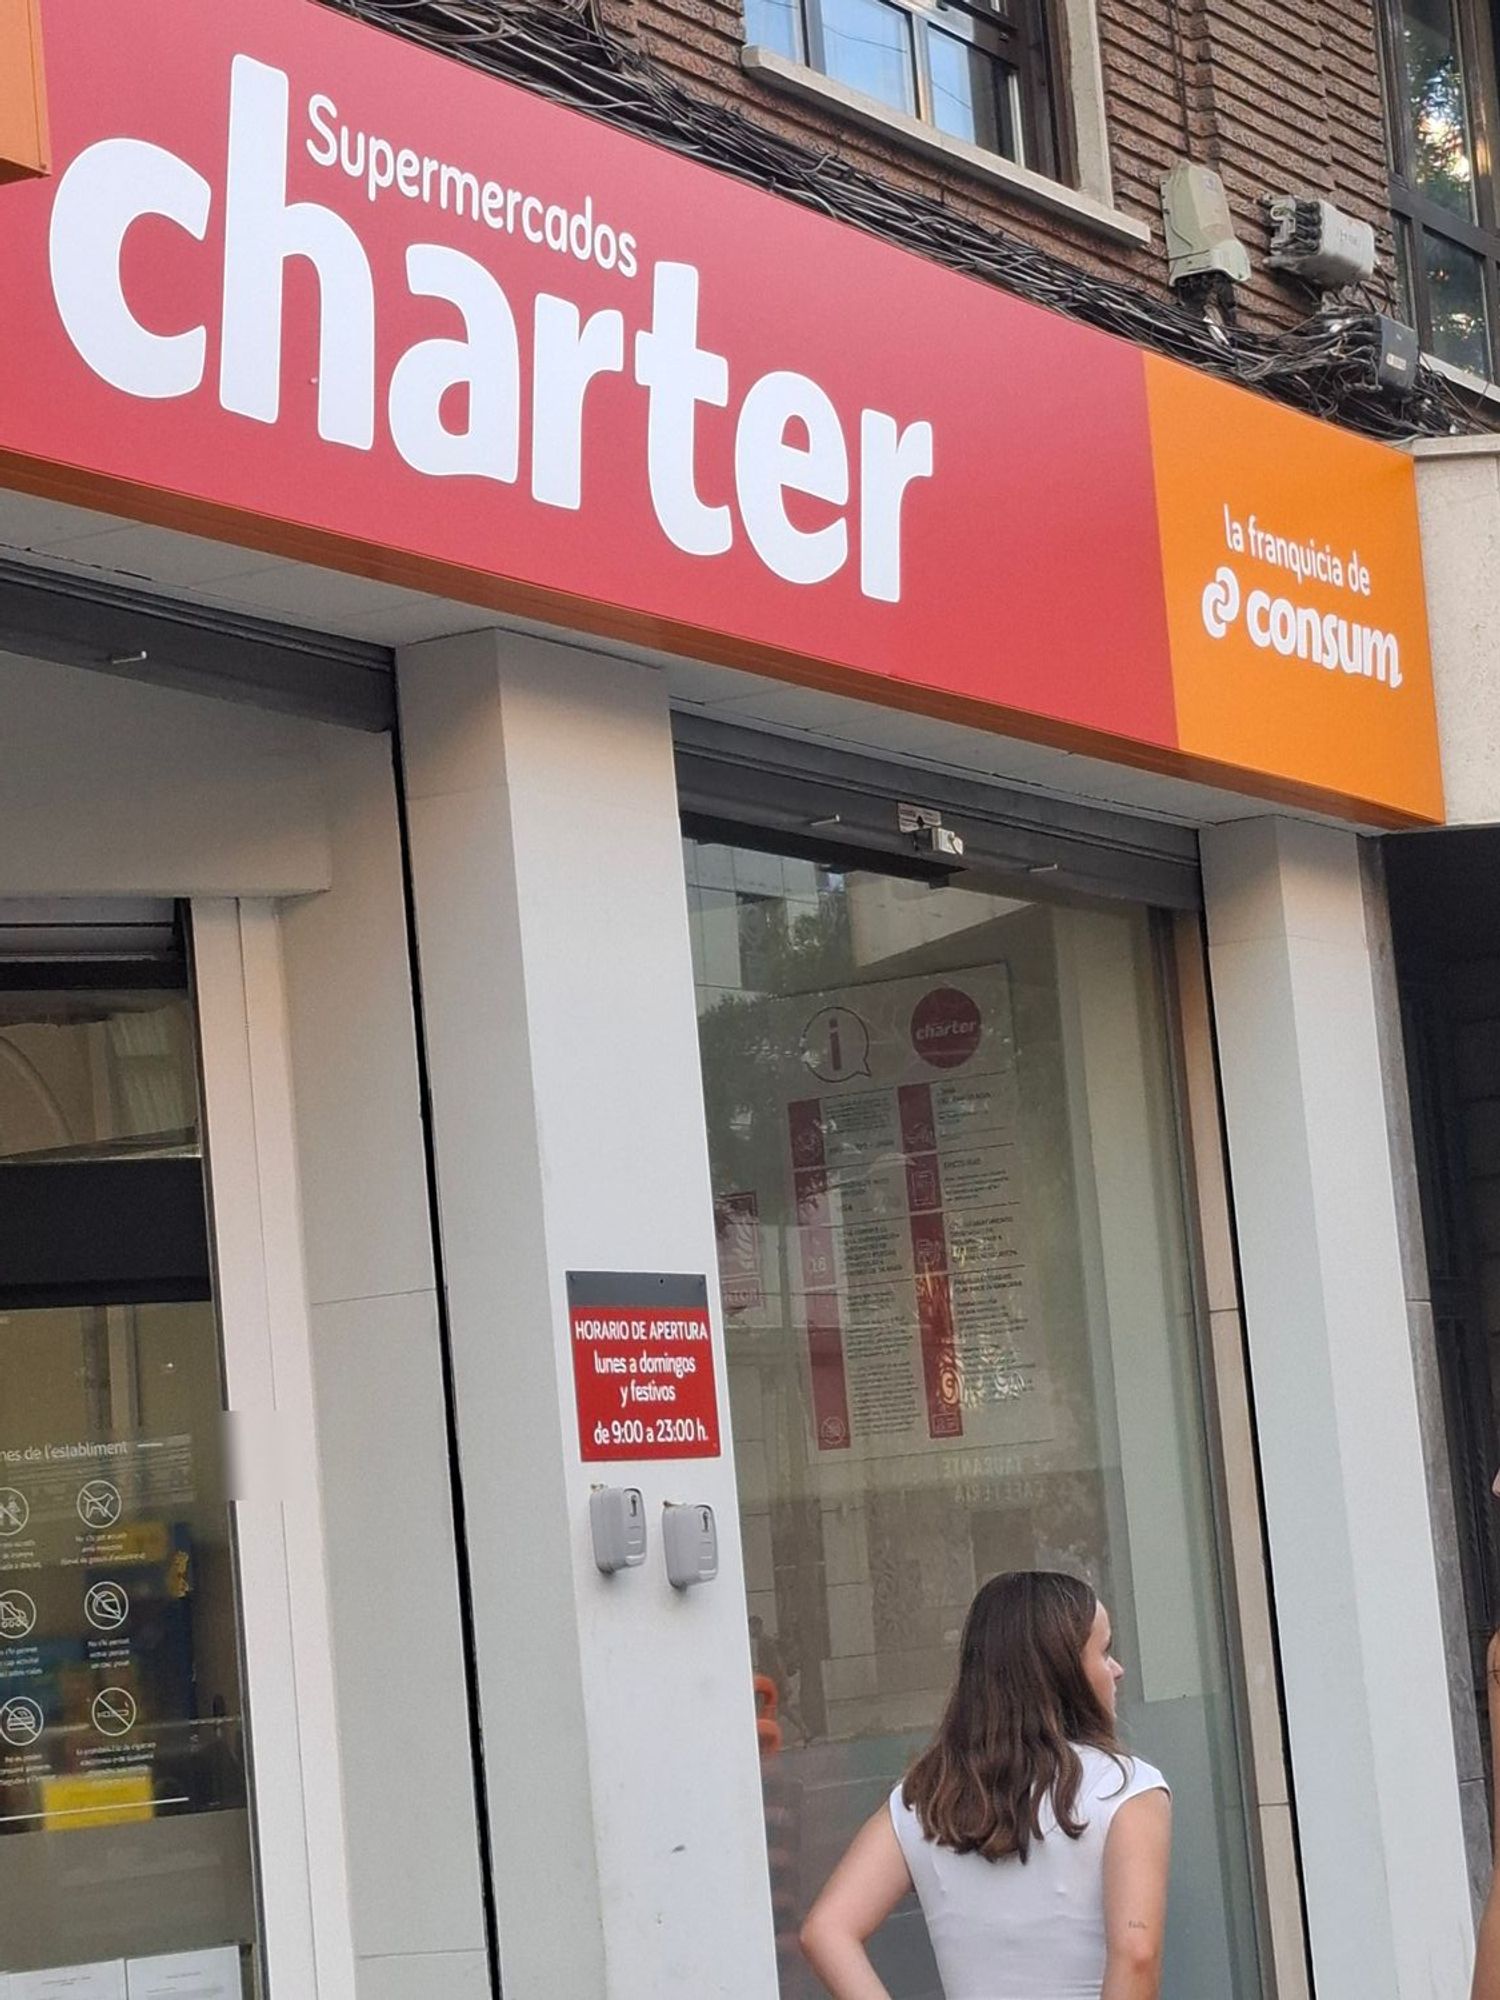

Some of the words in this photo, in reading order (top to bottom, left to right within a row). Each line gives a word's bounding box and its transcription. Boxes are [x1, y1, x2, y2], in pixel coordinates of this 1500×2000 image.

[305, 94, 638, 278] Supermercados
[49, 53, 933, 603] charter
[1223, 503, 1245, 553] la
[1248, 514, 1344, 584] franquicia
[1347, 550, 1371, 596] de
[1246, 590, 1403, 688] consum
[916, 1020, 977, 1041] charter
[575, 1320, 630, 1341] HORARIO
[631, 1321, 648, 1341] DE
[649, 1321, 709, 1341] APERTURA
[594, 1350, 627, 1374] lunes
[629, 1358, 638, 1372] a
[639, 1350, 696, 1379] domingos
[620, 1385, 629, 1408] y
[630, 1379, 676, 1402] festivos
[594, 1421, 610, 1445] de
[611, 1420, 644, 1444] 9:00
[646, 1426, 655, 1443] a
[656, 1418, 695, 1442] 23:00
[25, 1446, 41, 1460] de
[44, 1441, 128, 1460] l'establiment
